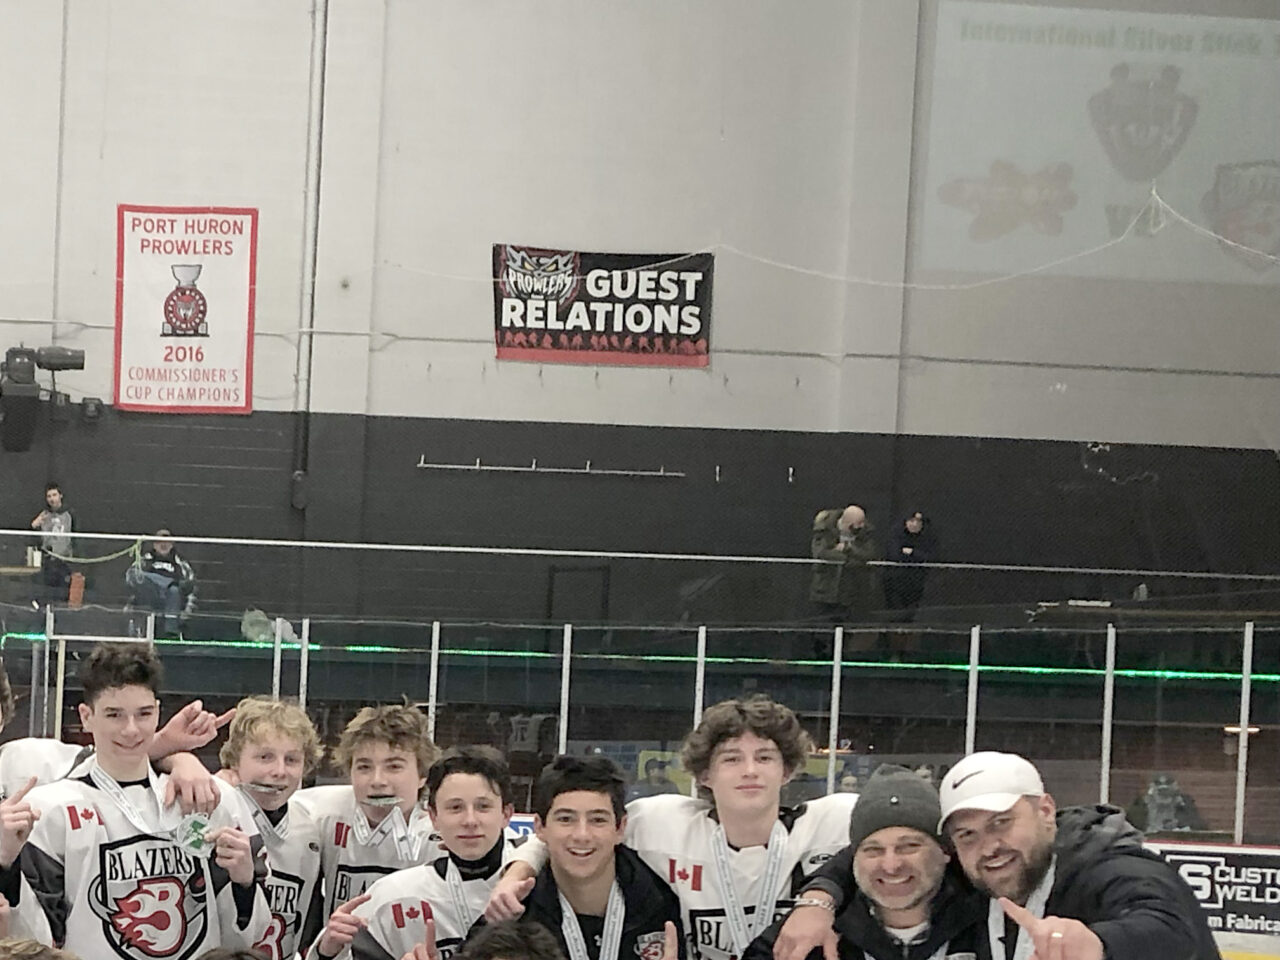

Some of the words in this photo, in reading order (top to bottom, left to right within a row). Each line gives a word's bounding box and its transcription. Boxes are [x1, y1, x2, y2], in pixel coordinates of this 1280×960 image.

[132, 217, 177, 234] PORT
[184, 219, 243, 235] HURON
[140, 239, 233, 255] PROWLERS
[585, 269, 703, 301] GUEST
[501, 298, 702, 335] RELATIONS
[163, 345, 205, 362] 2016
[128, 366, 239, 383] COMMISSIONER'S
[126, 385, 152, 400] CUP
[158, 387, 240, 402] CHAMPIONS
[107, 846, 194, 881] BLAZERS
